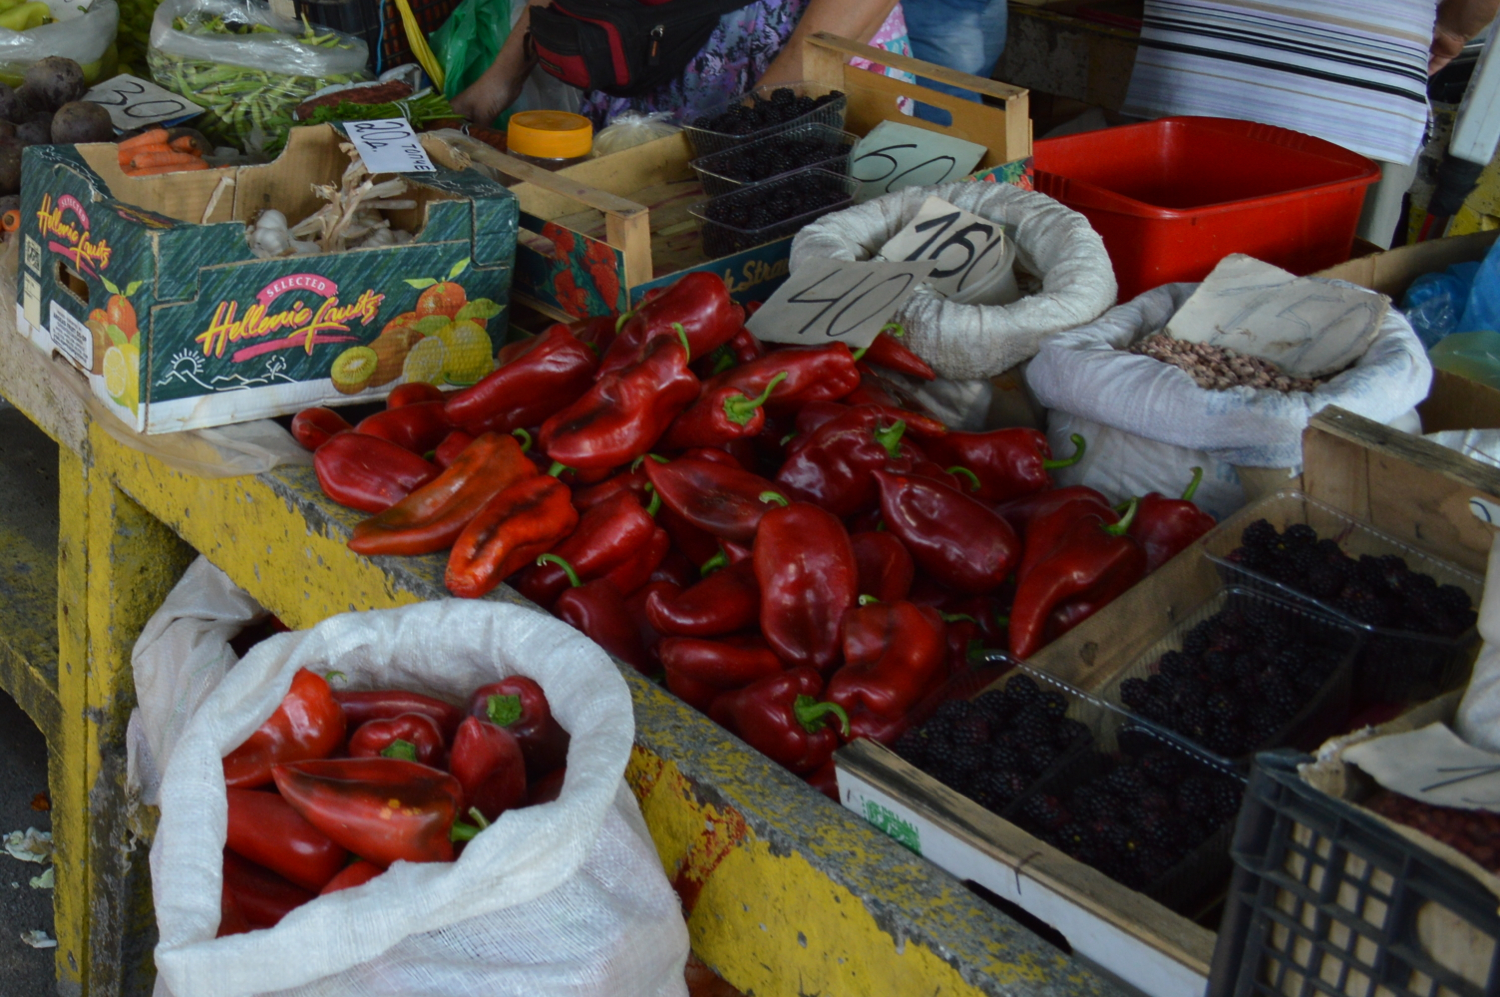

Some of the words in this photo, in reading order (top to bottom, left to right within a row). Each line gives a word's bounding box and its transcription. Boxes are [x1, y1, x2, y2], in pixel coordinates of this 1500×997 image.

[99, 81, 186, 118] 30
[266, 276, 327, 298] SELECTED
[787, 268, 914, 337] 40
[195, 300, 313, 359] Hellenic
